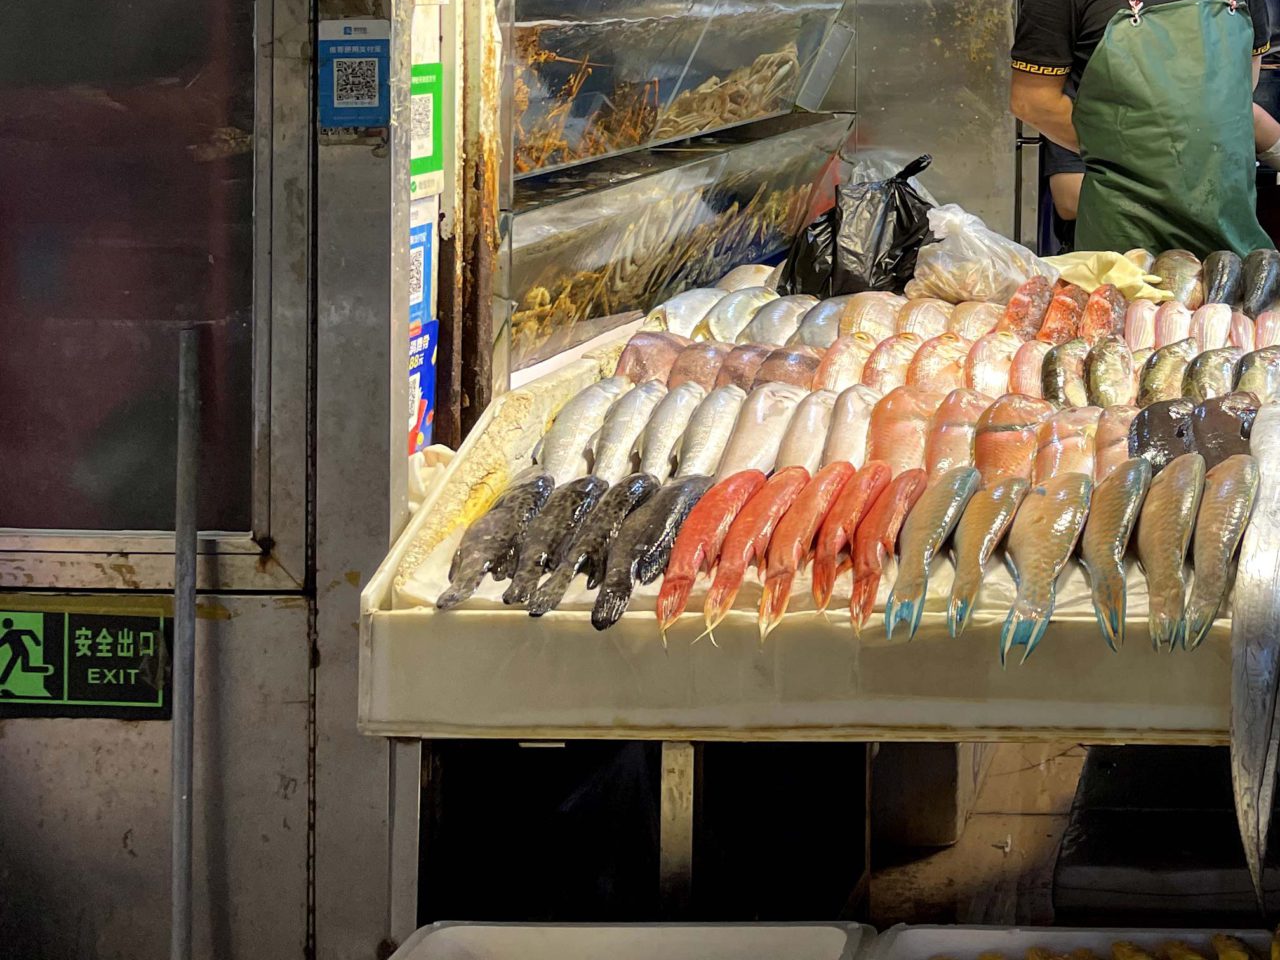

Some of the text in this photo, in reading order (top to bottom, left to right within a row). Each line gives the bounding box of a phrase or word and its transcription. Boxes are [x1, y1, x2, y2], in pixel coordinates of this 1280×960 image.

[75, 627, 155, 657] 安全出口
[87, 668, 140, 685] EXIT
